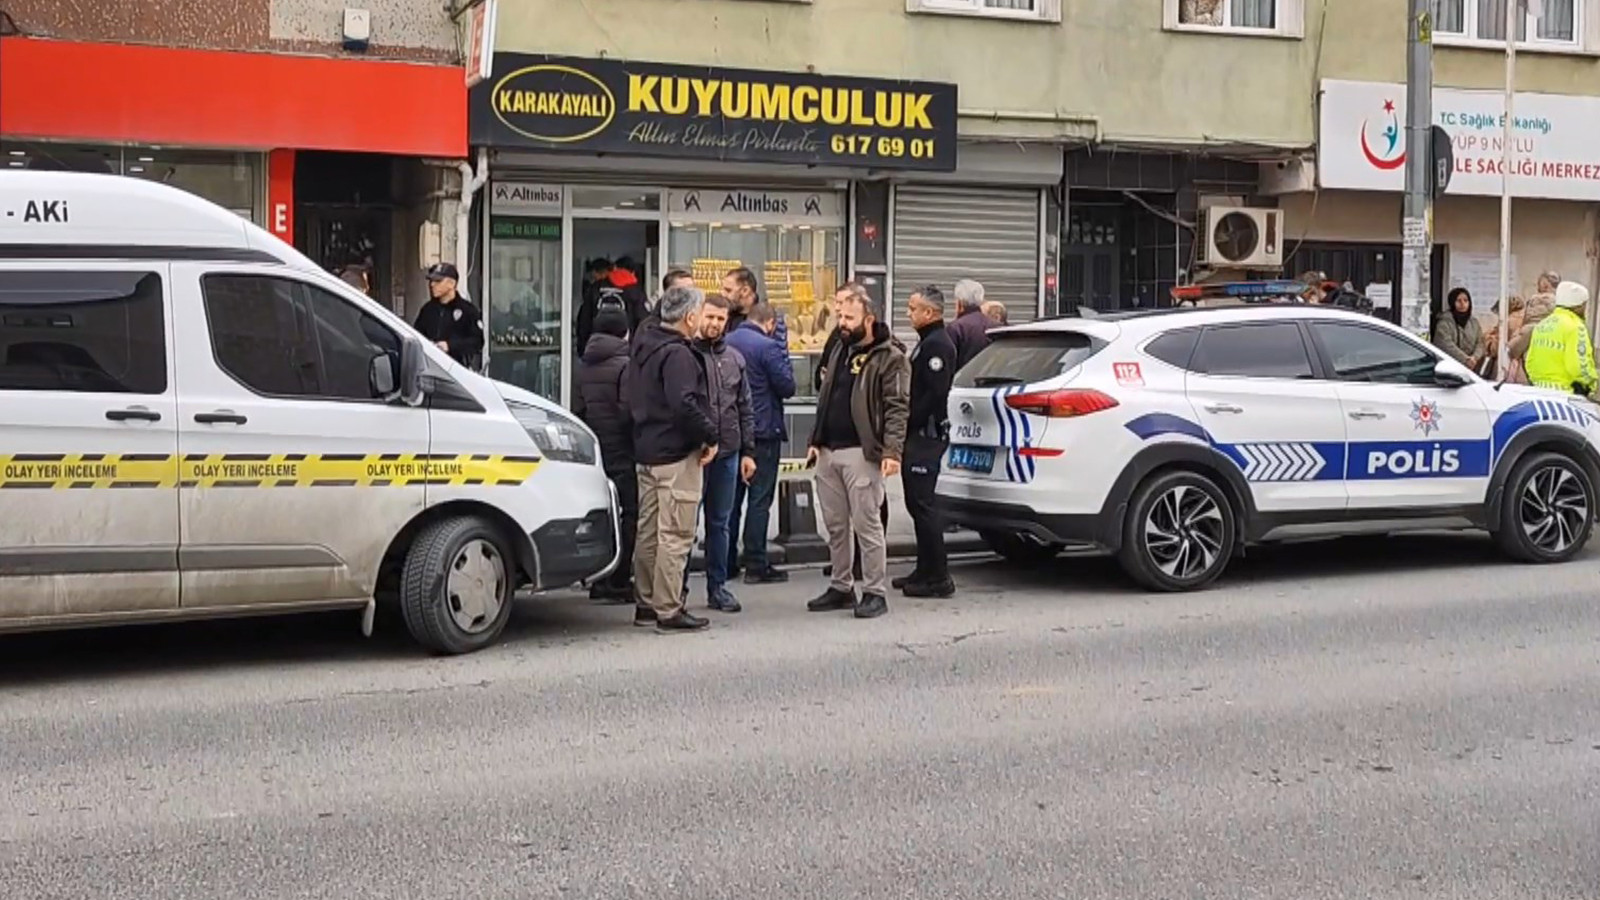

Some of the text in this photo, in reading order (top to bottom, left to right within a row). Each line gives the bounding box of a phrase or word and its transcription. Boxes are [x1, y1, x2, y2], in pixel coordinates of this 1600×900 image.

[499, 89, 606, 117] KARAKAYALI
[628, 74, 934, 129] KUYUMCULUK
[1459, 113, 1496, 130] Sağlık
[1499, 115, 1552, 135] Bkanlığı
[830, 134, 935, 159] 617 69 01
[1451, 132, 1477, 149] YÜP
[1481, 135, 1489, 151] 9
[1115, 363, 1139, 379] 112
[956, 421, 983, 439] POLİS
[1367, 443, 1460, 474] POLİS
[4, 464, 34, 479] OLAY
[193, 464, 221, 478] OLAY
[366, 463, 391, 476] OLAY
